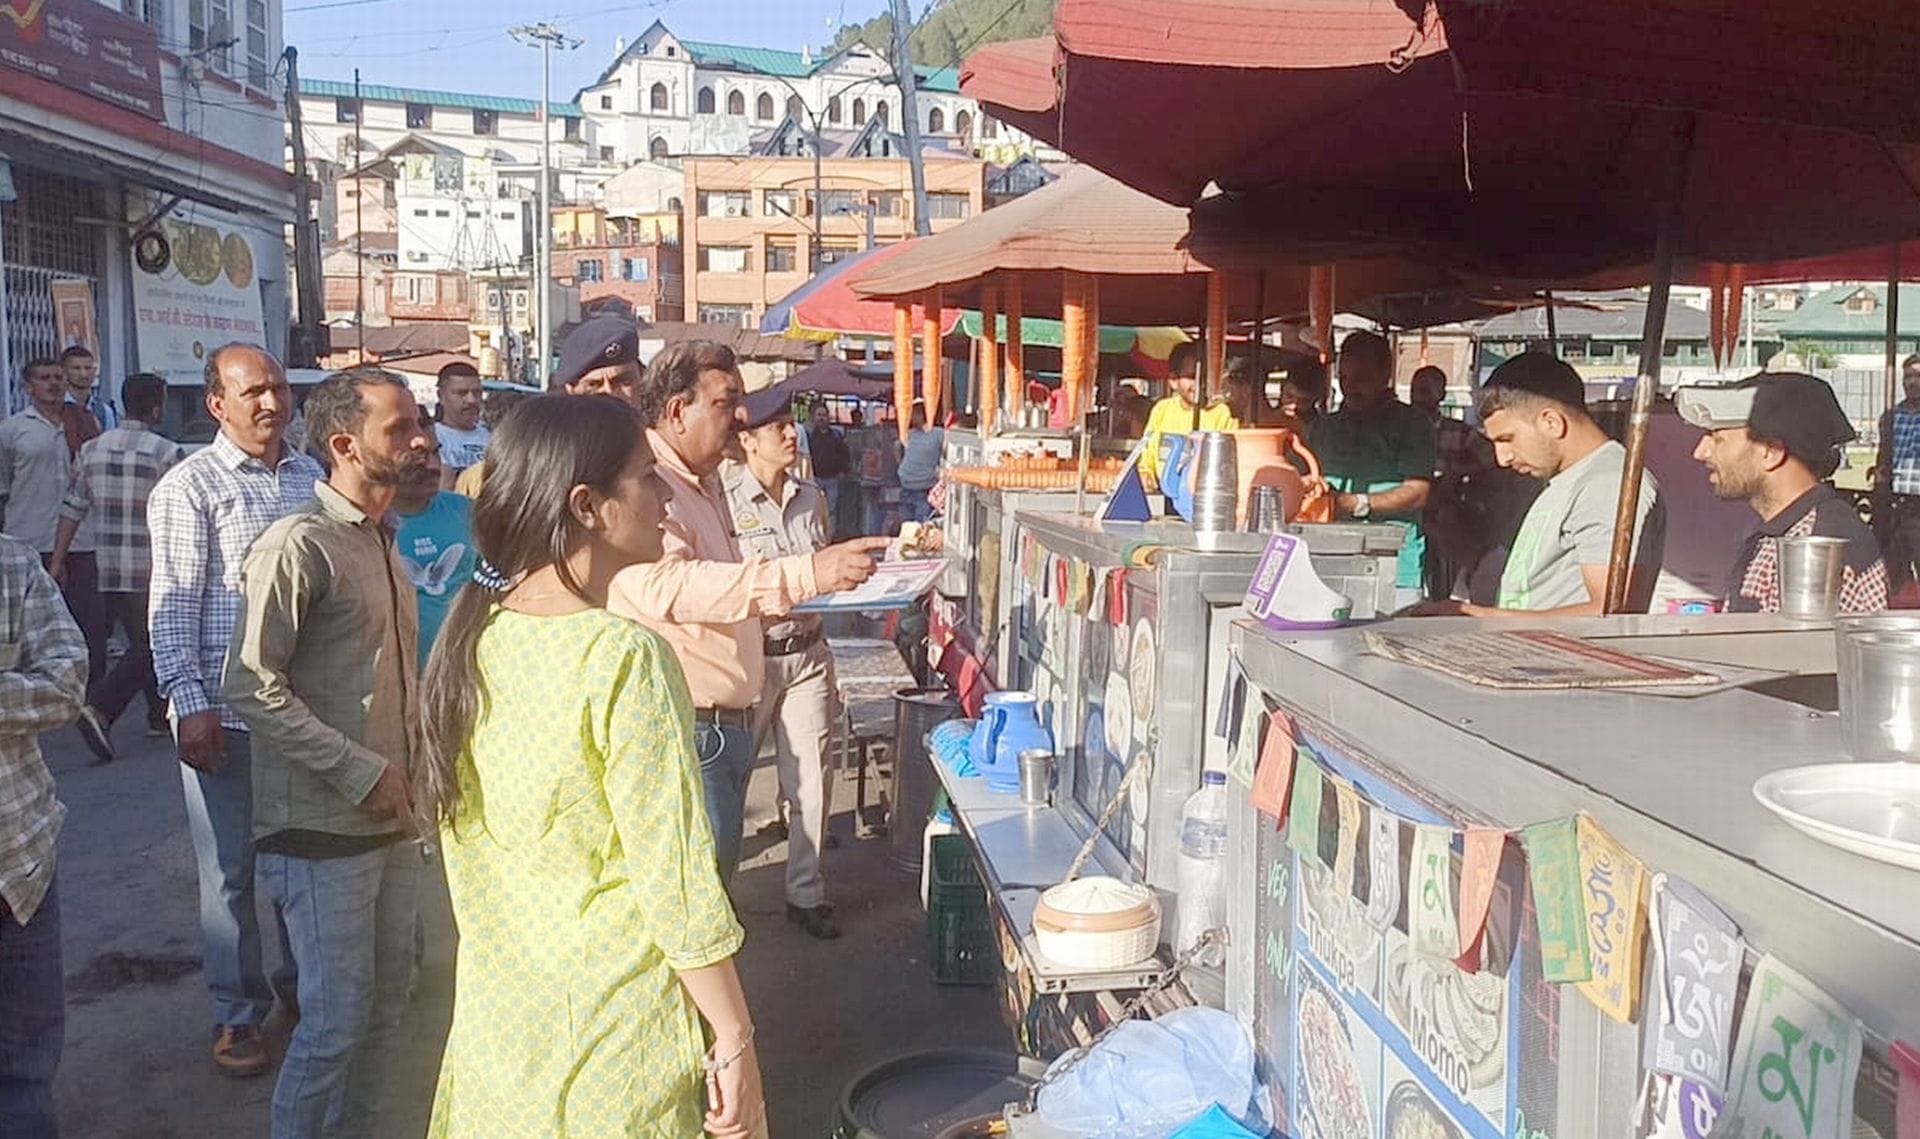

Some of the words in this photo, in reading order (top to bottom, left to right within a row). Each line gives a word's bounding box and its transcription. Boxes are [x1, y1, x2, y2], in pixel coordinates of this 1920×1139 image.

[1267, 859, 1289, 907] VEG
[1266, 929, 1294, 997] ONLY
[1307, 910, 1356, 989] Thukpa
[1412, 1006, 1468, 1096] Momo
